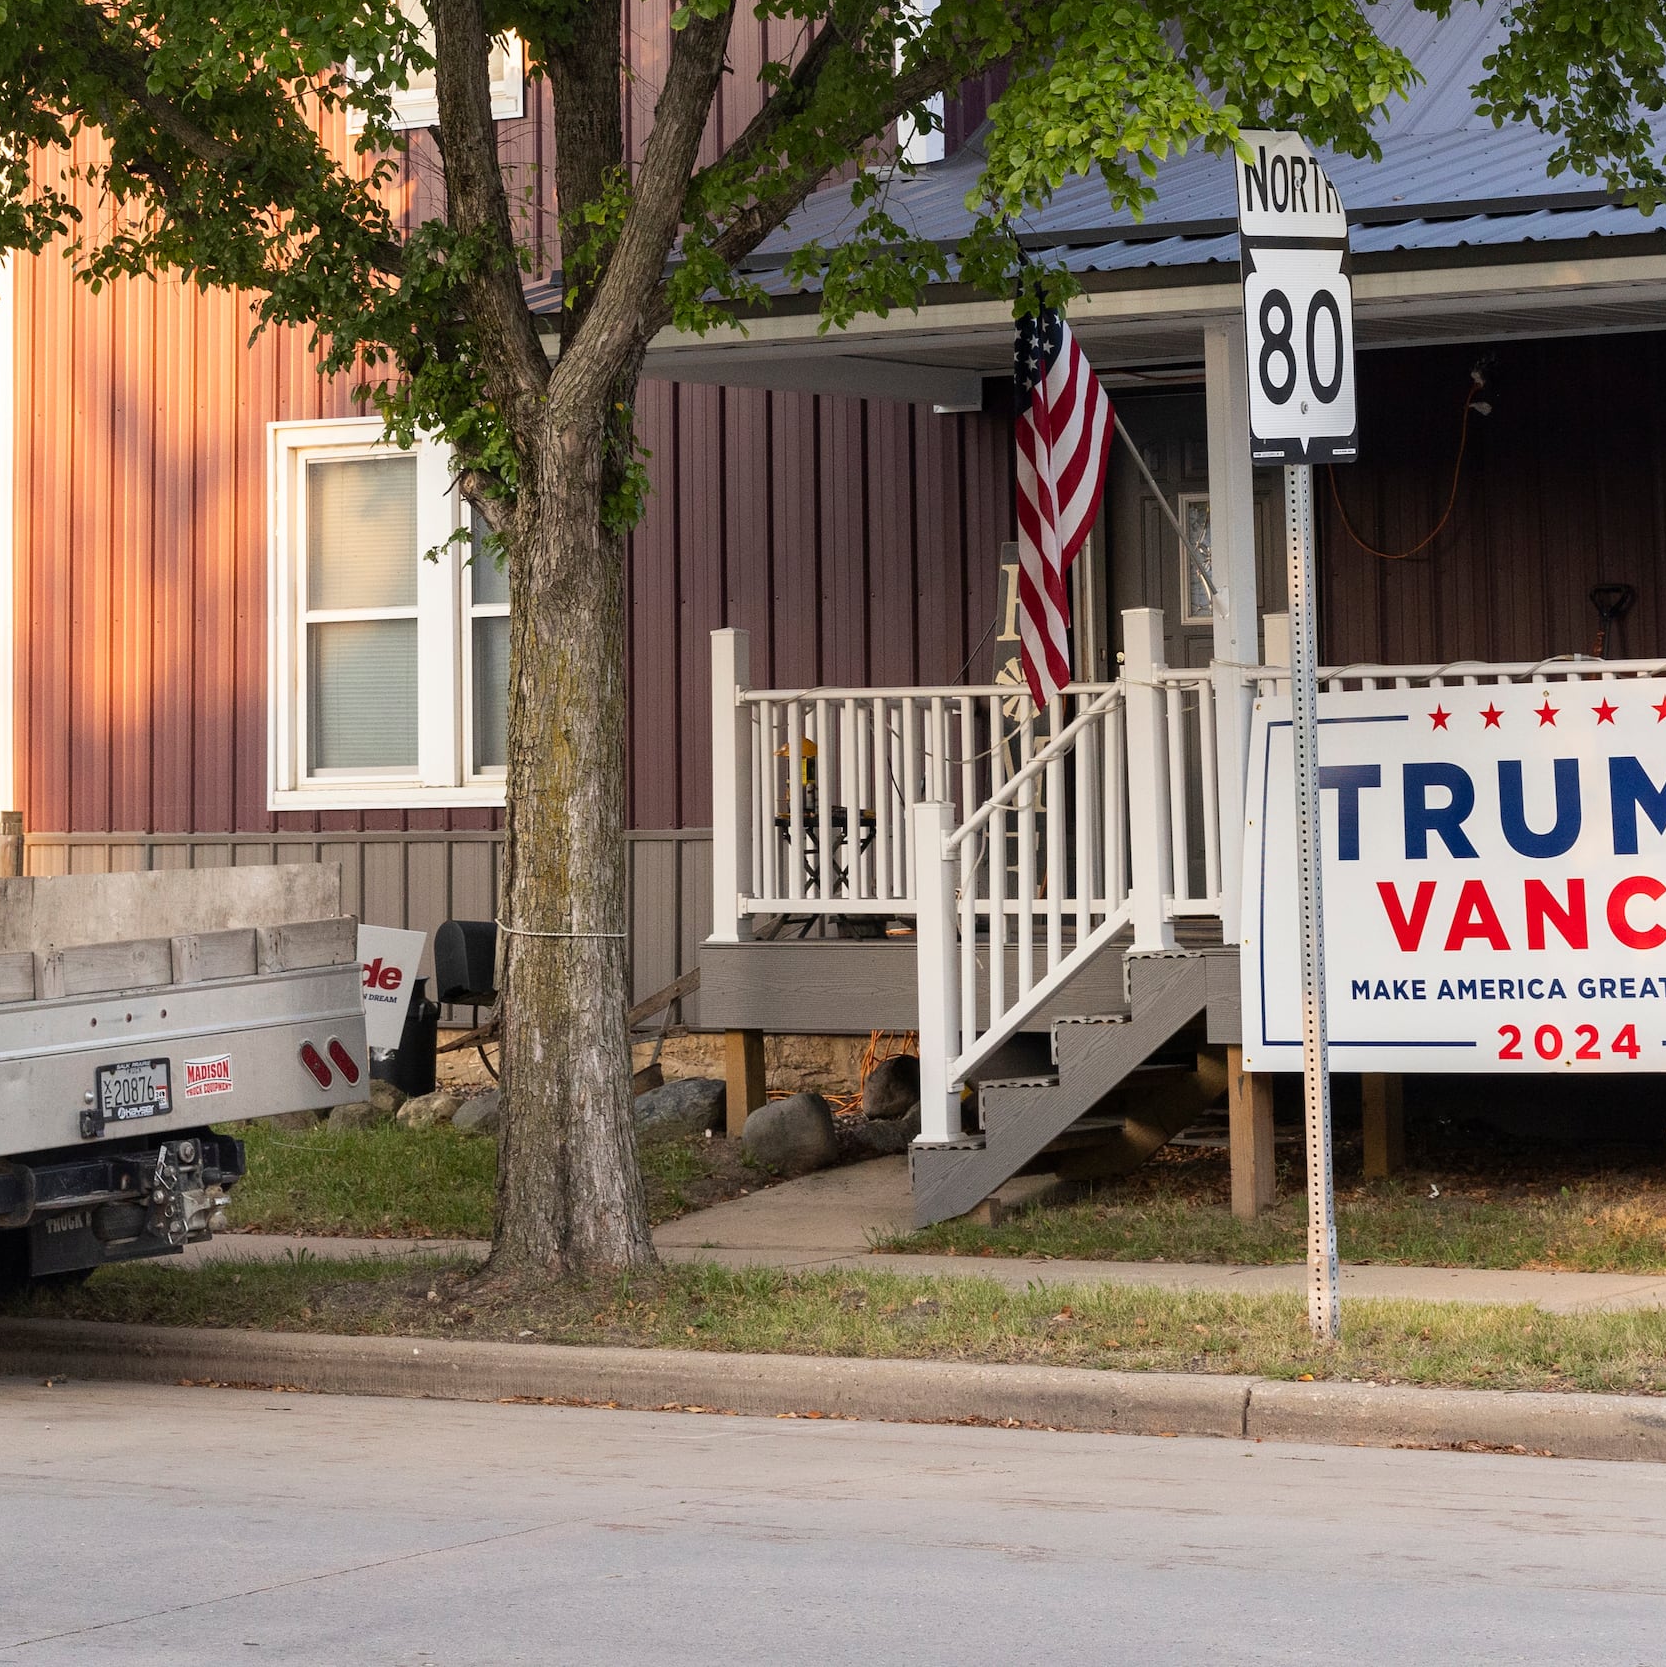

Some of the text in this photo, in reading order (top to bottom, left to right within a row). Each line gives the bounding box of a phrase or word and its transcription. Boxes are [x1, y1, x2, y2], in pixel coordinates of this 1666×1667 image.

[1244, 145, 1341, 214] NORTH
[1259, 288, 1344, 405] 80
[369, 994, 398, 1004] DREAM
[1351, 978, 1427, 1001] MAKE
[1437, 977, 1568, 1000] AMERICA
[1497, 1023, 1642, 1061] 2024
[187, 1059, 229, 1084] MADISON
[114, 1075, 155, 1106] 20876
[45, 1212, 84, 1234] TRUCK
